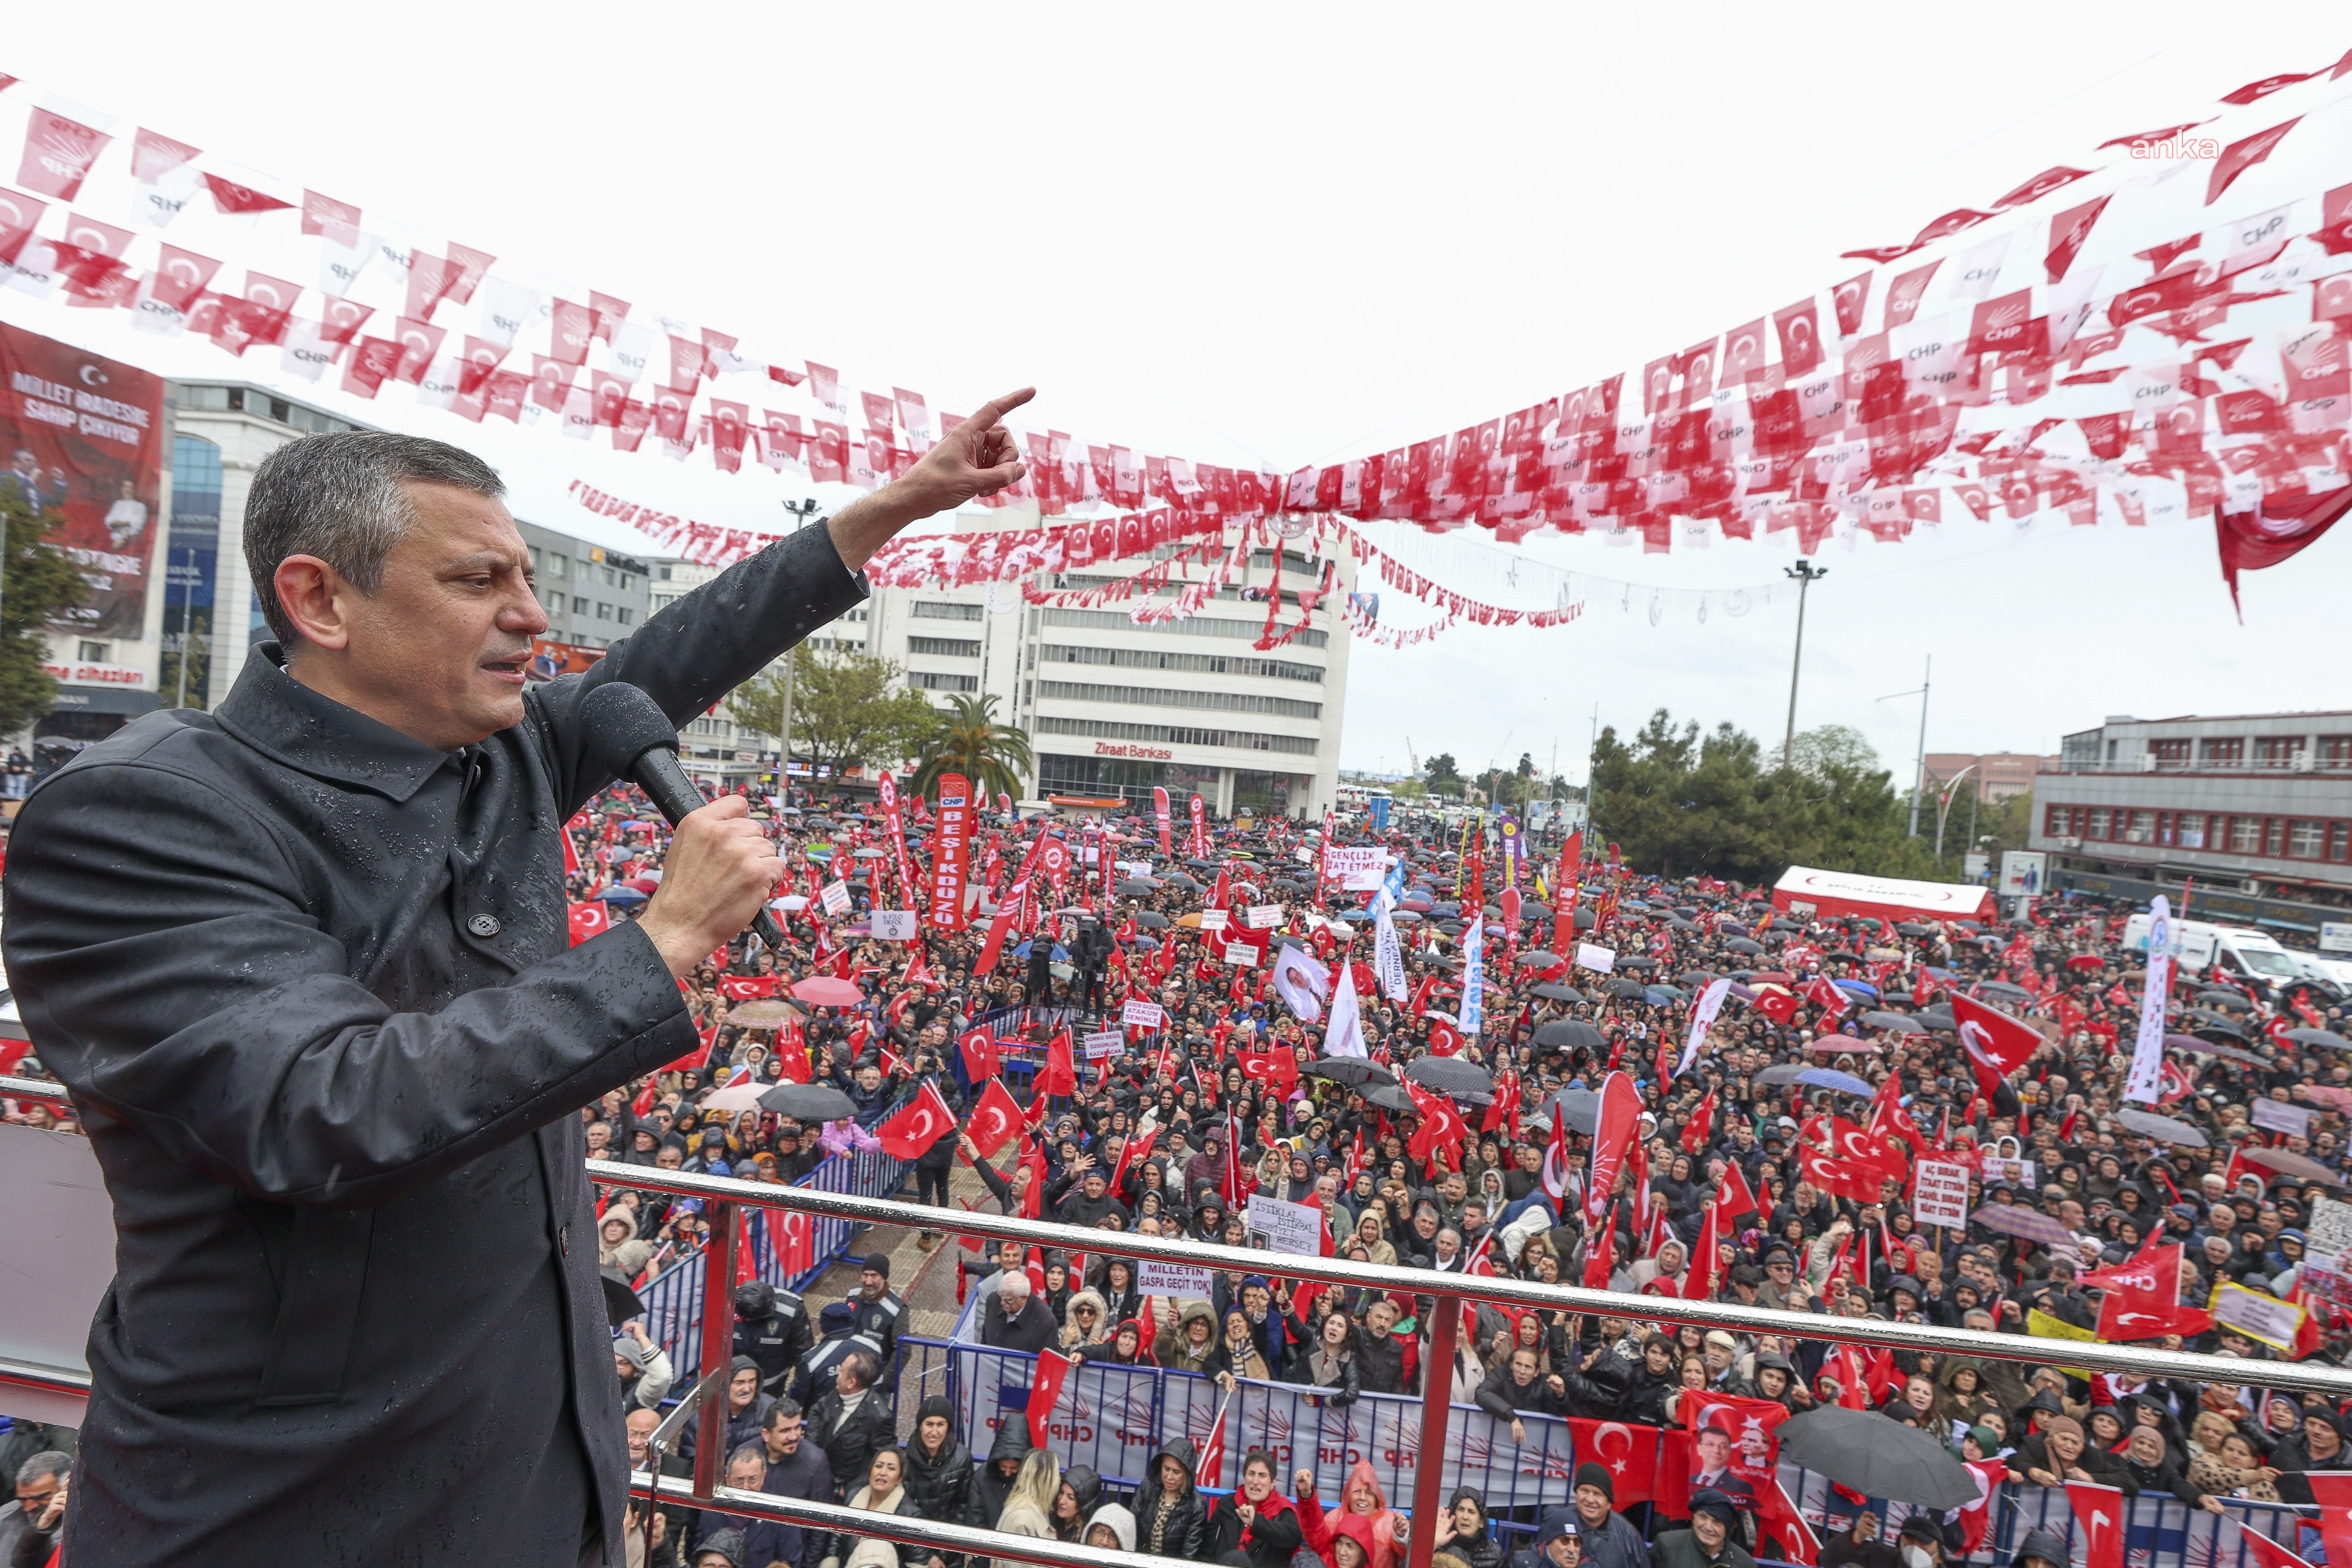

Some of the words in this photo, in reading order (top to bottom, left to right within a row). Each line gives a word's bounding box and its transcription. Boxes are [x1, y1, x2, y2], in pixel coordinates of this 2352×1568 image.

[2243, 216, 2284, 247] CHP
[1892, 299, 1918, 312] CH
[1985, 324, 2021, 341] CHP
[294, 349, 329, 364] CHP
[1909, 343, 1942, 360] CHP
[1850, 368, 1879, 383] CHP
[2302, 362, 2340, 380] CHP
[1805, 383, 1829, 397] CHP
[2136, 384, 2170, 398] CHP
[1622, 425, 1644, 436] CHP
[1823, 451, 1849, 463] CHP
[1871, 500, 1896, 511] CHP
[1095, 742, 1127, 756] Ziraat
[1130, 745, 1172, 759] Bankası
[1331, 850, 1376, 862] GENÇLİK
[1328, 859, 1346, 870] İAT
[1349, 862, 1383, 871] ETMEZ
[1127, 1007, 1158, 1016] ATAKUM
[1925, 1164, 1936, 1177] AÇ
[1937, 1166, 1959, 1177] BIRAK
[1921, 1175, 1942, 1188] İTAAT
[1919, 1189, 1939, 1201] CAHİL
[1942, 1194, 1964, 1205] BIRAK
[1140, 1276, 1165, 1287] GASPA
[1167, 1276, 1190, 1292] GEÇİT
